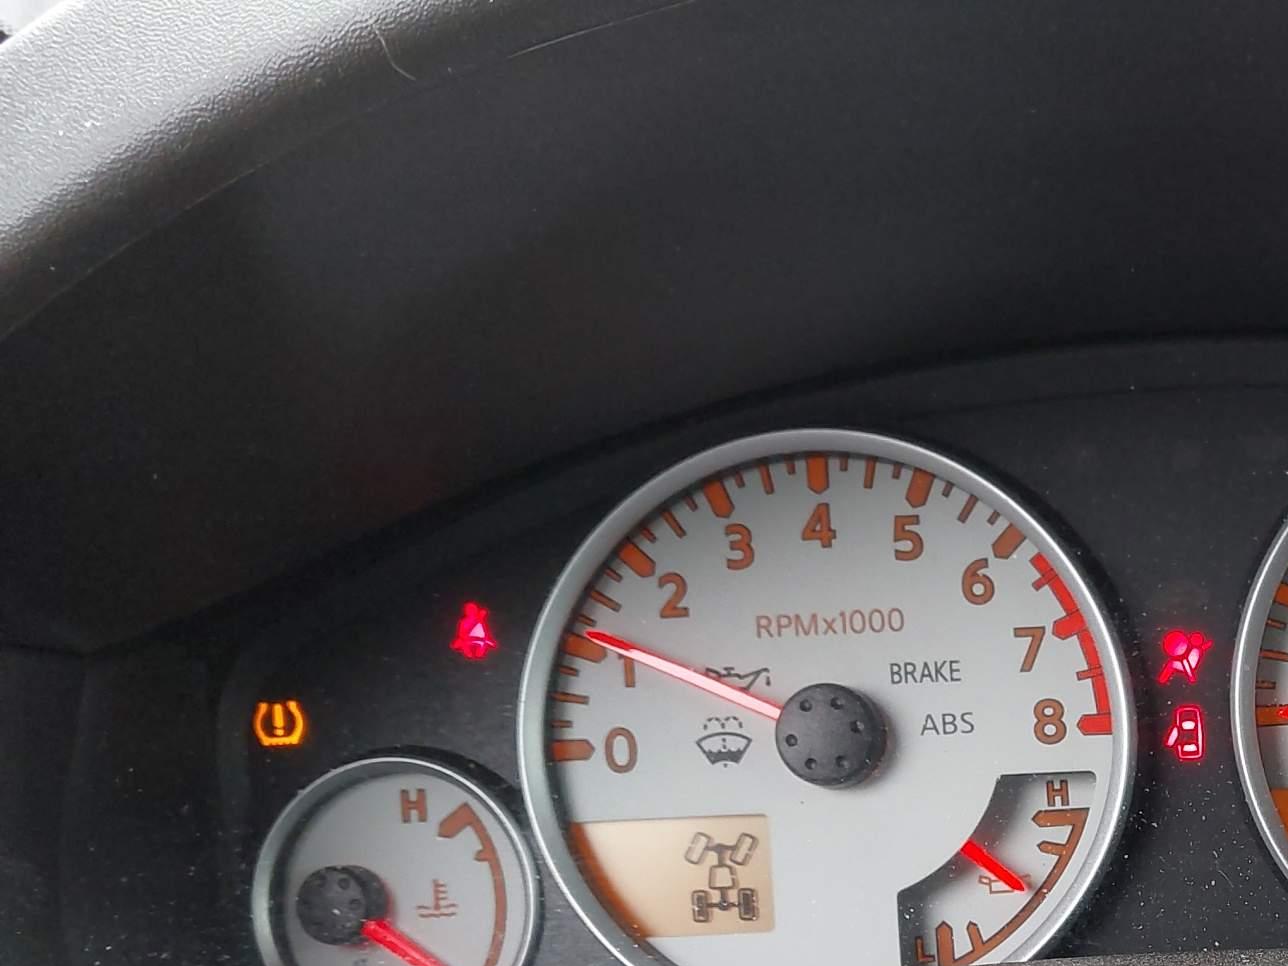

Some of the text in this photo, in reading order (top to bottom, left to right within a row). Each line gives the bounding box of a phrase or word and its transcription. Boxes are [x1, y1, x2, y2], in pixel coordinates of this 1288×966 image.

[725, 523, 754, 570] 3
[801, 503, 836, 547] 4
[893, 515, 924, 561] 5
[657, 572, 690, 618] 2
[961, 558, 995, 605] 6
[755, 607, 905, 640] RPMx1000
[1013, 627, 1046, 672] 7
[889, 661, 962, 684] BRAKE
[920, 711, 975, 736] ABS
[1033, 698, 1066, 744] 8
[604, 726, 638, 774] 0
[399, 788, 428, 823] H
[1046, 779, 1070, 807] H
[914, 936, 936, 963] L
